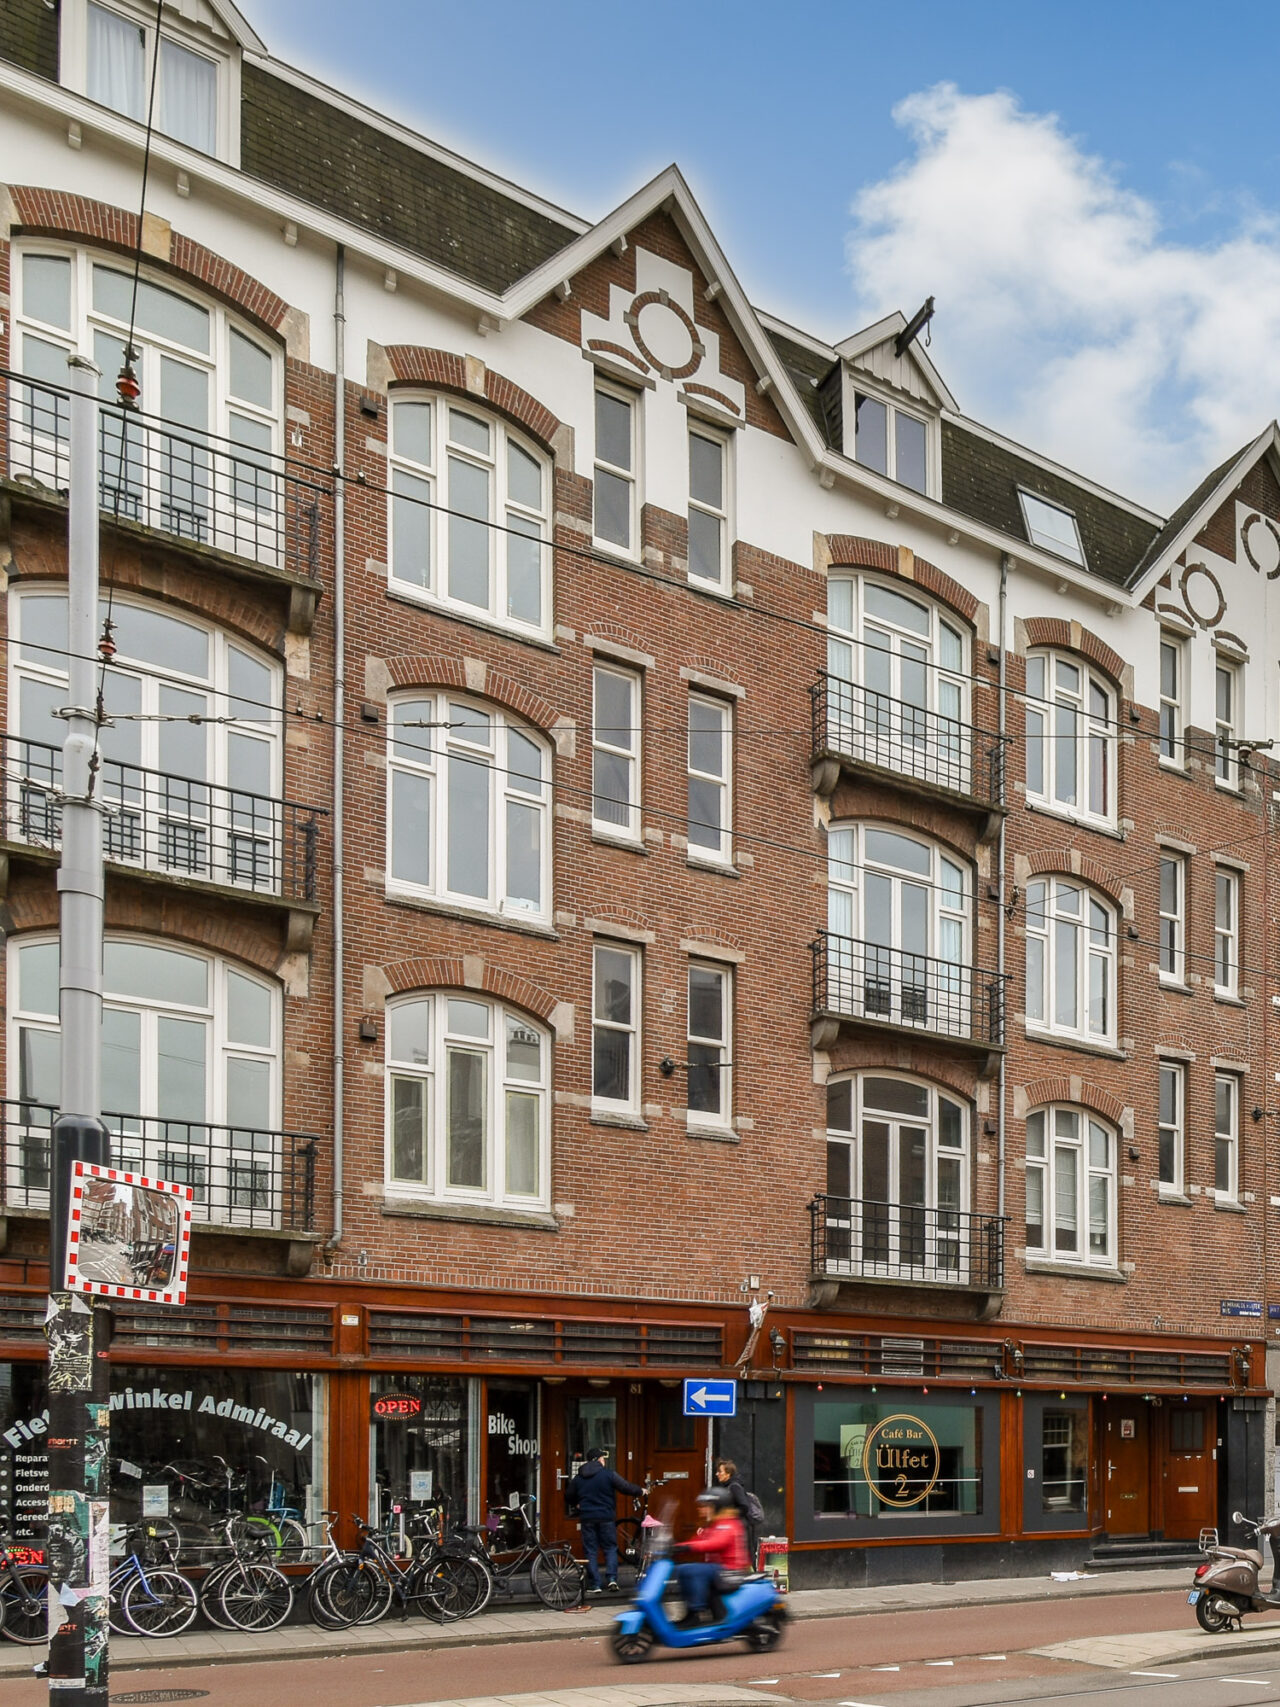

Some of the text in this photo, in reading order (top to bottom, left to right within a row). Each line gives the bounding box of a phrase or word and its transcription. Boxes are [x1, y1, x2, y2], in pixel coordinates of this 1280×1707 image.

[374, 1400, 421, 1414] OPEN
[197, 1395, 313, 1451] Admiraal
[488, 1412, 516, 1435] Bike
[881, 1428, 923, 1439] Café Bar
[507, 1434, 538, 1459] Shop
[875, 1443, 930, 1469] Ülfet
[15, 1454, 50, 1464] Repara
[894, 1473, 910, 1498] 2
[15, 1528, 34, 1536] etc.
